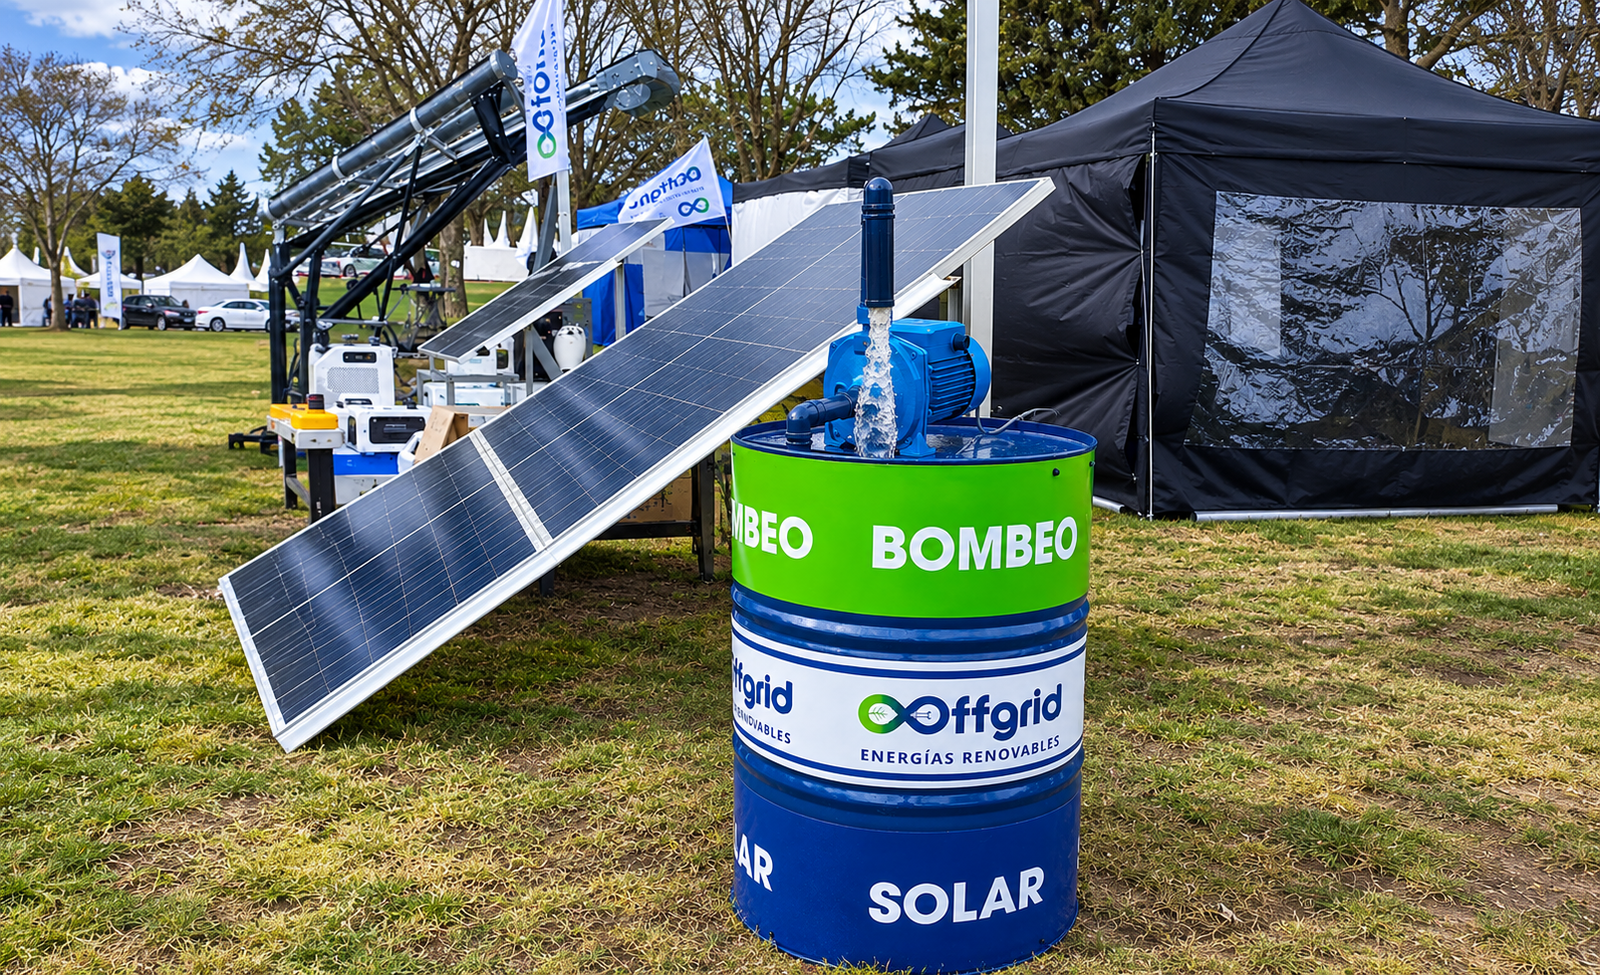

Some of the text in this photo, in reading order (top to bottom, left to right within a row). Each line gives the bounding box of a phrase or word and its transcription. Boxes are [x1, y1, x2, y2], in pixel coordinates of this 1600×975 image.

[872, 516, 1077, 571] BOMBEO
[734, 657, 793, 714] ffgrid
[904, 683, 1062, 741] Offgrid
[861, 735, 1060, 765] ENERGÍAS RENOVABLES
[868, 866, 1045, 924] SOLAR
